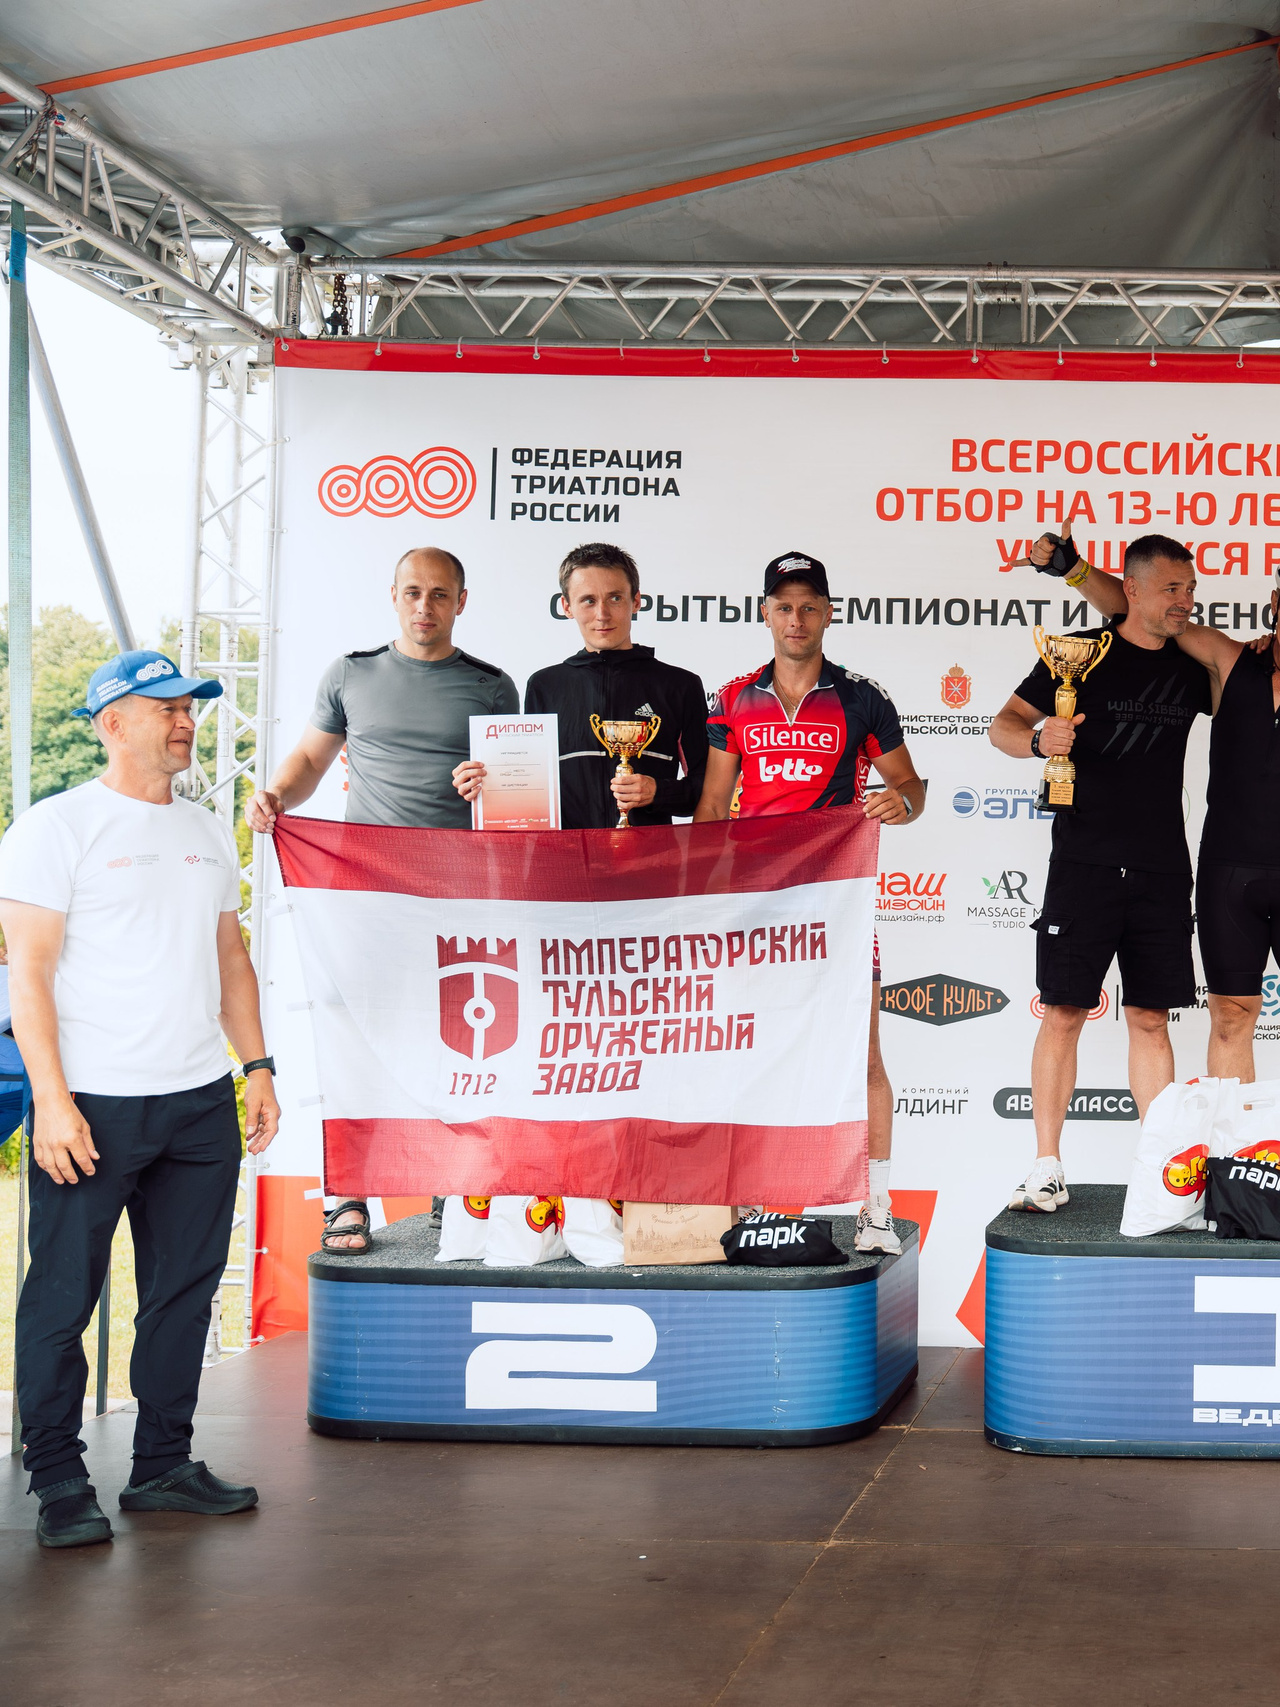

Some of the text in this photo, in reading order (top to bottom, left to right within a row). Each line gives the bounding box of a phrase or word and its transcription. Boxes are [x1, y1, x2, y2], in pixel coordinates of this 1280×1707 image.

[510, 447, 683, 471] ФЕДЕРАЦИЯ
[510, 474, 681, 498] ТРИАТЛОНА
[510, 501, 621, 524] РОССИИ
[875, 486, 1023, 523] ОТБОР
[1036, 489, 1097, 526] НА
[1108, 490, 1218, 528] 13-Ю
[828, 596, 1051, 627] ЕМПИОНАТ
[1062, 599, 1089, 627] И
[899, 714, 979, 724] НИСТЕРСТВО
[901, 723, 958, 735] ЛЬСКОЙ
[485, 723, 544, 740] ДИПЛОМ
[749, 725, 834, 749] Silence
[985, 788, 1031, 797] ГРУППА
[874, 912, 946, 924] ашдизайн.рф
[967, 906, 1027, 918] MASSAGE
[992, 920, 1026, 929] STUDIO
[539, 920, 829, 976] ИМПЕРАТОРСКИЙ
[541, 973, 715, 1018] ТУЛЬСКИЙ
[885, 983, 995, 1017] КОФЕ КУЛЬТ
[538, 1011, 756, 1060] ОРУЖЕЙНЫЙ
[448, 1071, 498, 1097] 1712
[532, 1059, 643, 1097] ЗАВОД
[902, 1086, 970, 1095] компаний
[465, 1300, 658, 1413] 2
